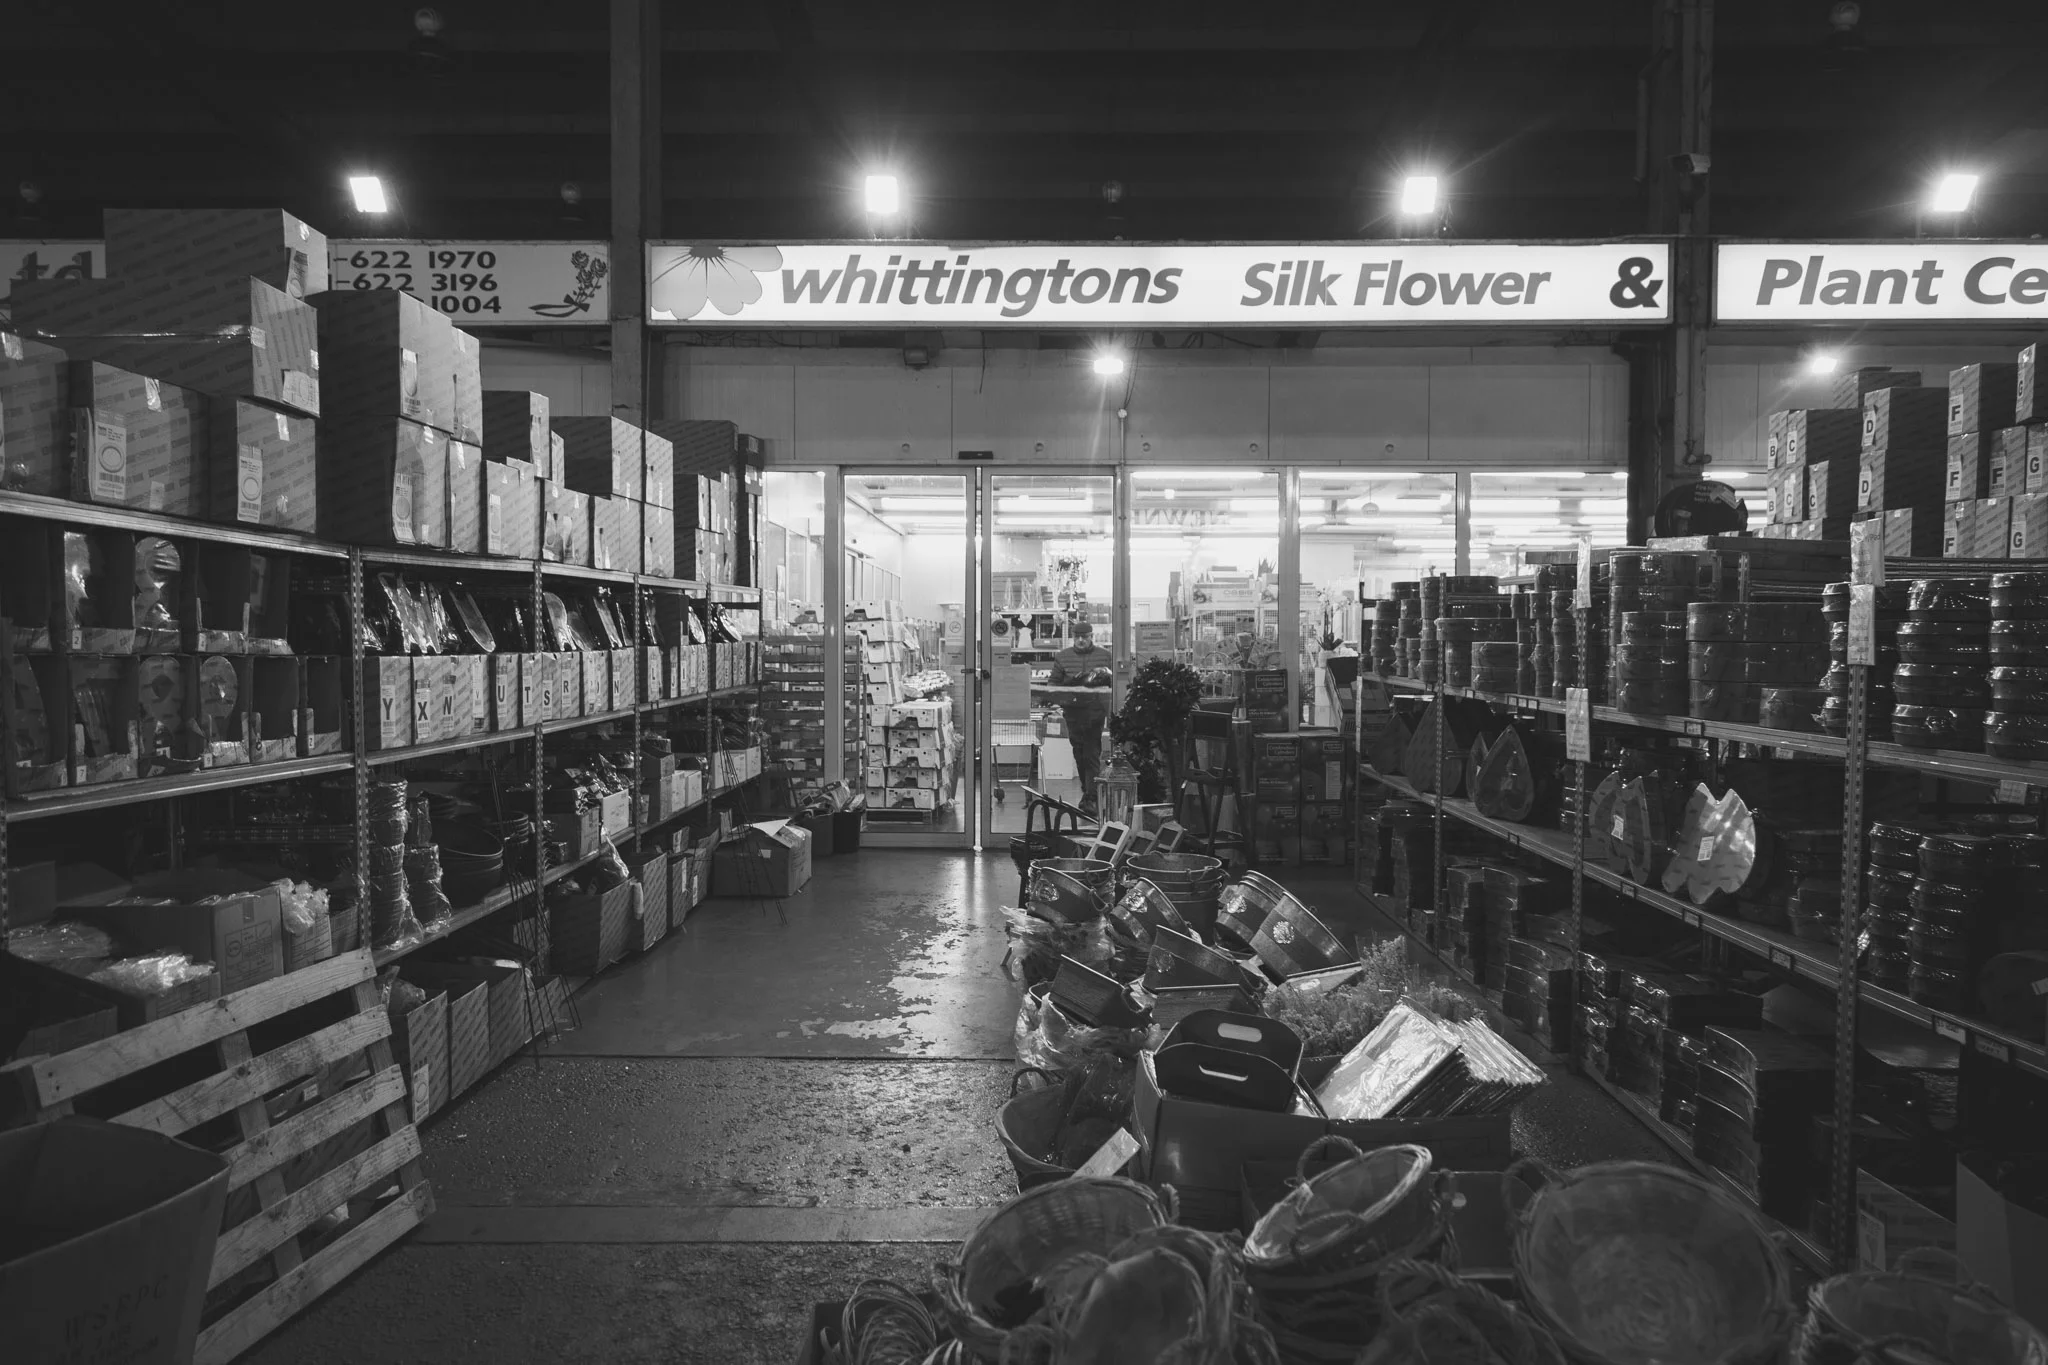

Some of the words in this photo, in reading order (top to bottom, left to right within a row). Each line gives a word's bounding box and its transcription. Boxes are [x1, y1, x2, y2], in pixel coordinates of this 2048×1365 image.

[429, 250, 496, 269] 1970
[431, 273, 498, 291] 3196
[781, 254, 1183, 317] whittingtons
[1240, 260, 1342, 306] Silk
[1353, 260, 1551, 306] Flower
[1609, 256, 1663, 308] &
[1756, 255, 1944, 305] Plant
[431, 295, 501, 313] 1004
[1951, 405, 1961, 421] F
[1866, 420, 1873, 433] D
[1770, 446, 1775, 457] B
[1789, 440, 1795, 452] C
[2030, 457, 2040, 473] G
[1950, 471, 1959, 487] F
[1992, 468, 2003, 484] F
[1861, 480, 1869, 493] D
[1769, 501, 1774, 512] B
[1786, 494, 1792, 506] C
[1810, 495, 1815, 507] C
[1944, 537, 1955, 553] F
[2013, 532, 2023, 548] G
[498, 685, 505, 702] U
[524, 686, 531, 703] T
[563, 680, 569, 693] R
[544, 690, 550, 706] S
[382, 698, 393, 720] Y
[418, 701, 428, 721] X
